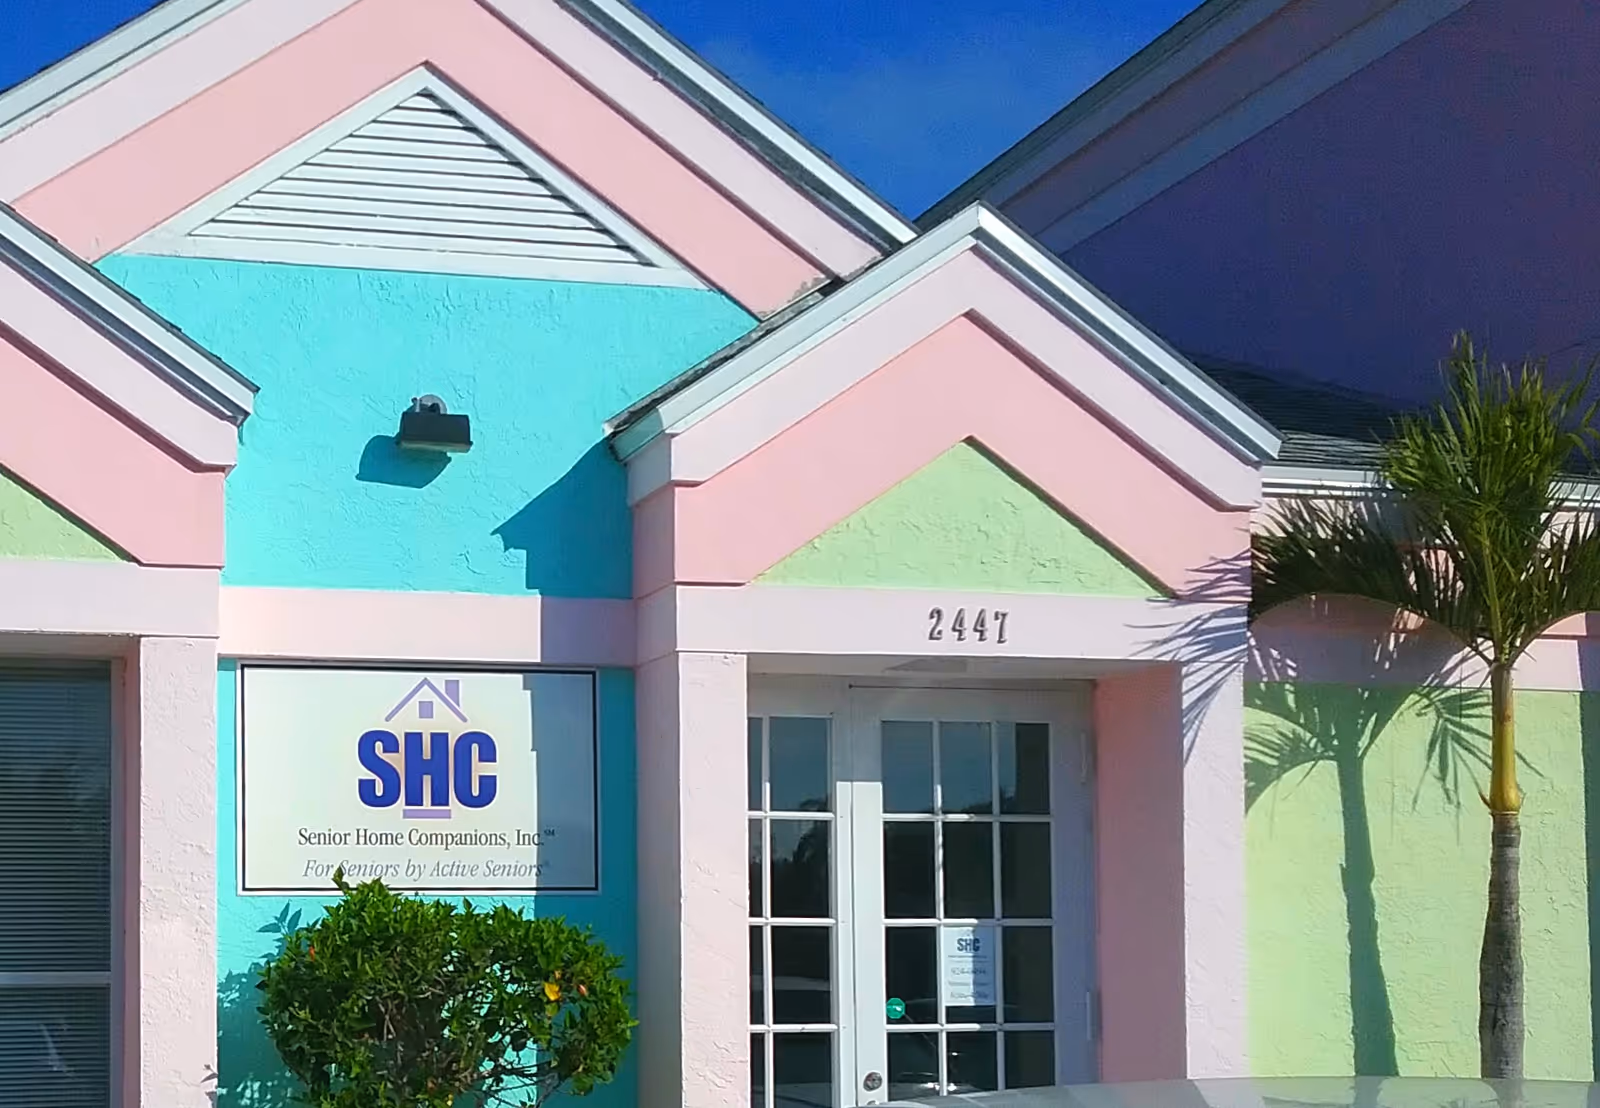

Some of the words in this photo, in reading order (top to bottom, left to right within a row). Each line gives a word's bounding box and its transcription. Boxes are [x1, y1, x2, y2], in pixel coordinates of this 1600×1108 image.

[927, 607, 1008, 644] 2447
[357, 729, 497, 808] SHC
[298, 827, 351, 846] Senior
[355, 828, 404, 846] Home
[408, 828, 511, 850] Companions,
[515, 829, 544, 846] Inc.
[302, 859, 334, 877] For
[339, 859, 400, 877] Seniors
[405, 858, 426, 882] by
[429, 859, 479, 877] Active
[483, 859, 544, 877] Seniors
[956, 937, 980, 952] SHC
